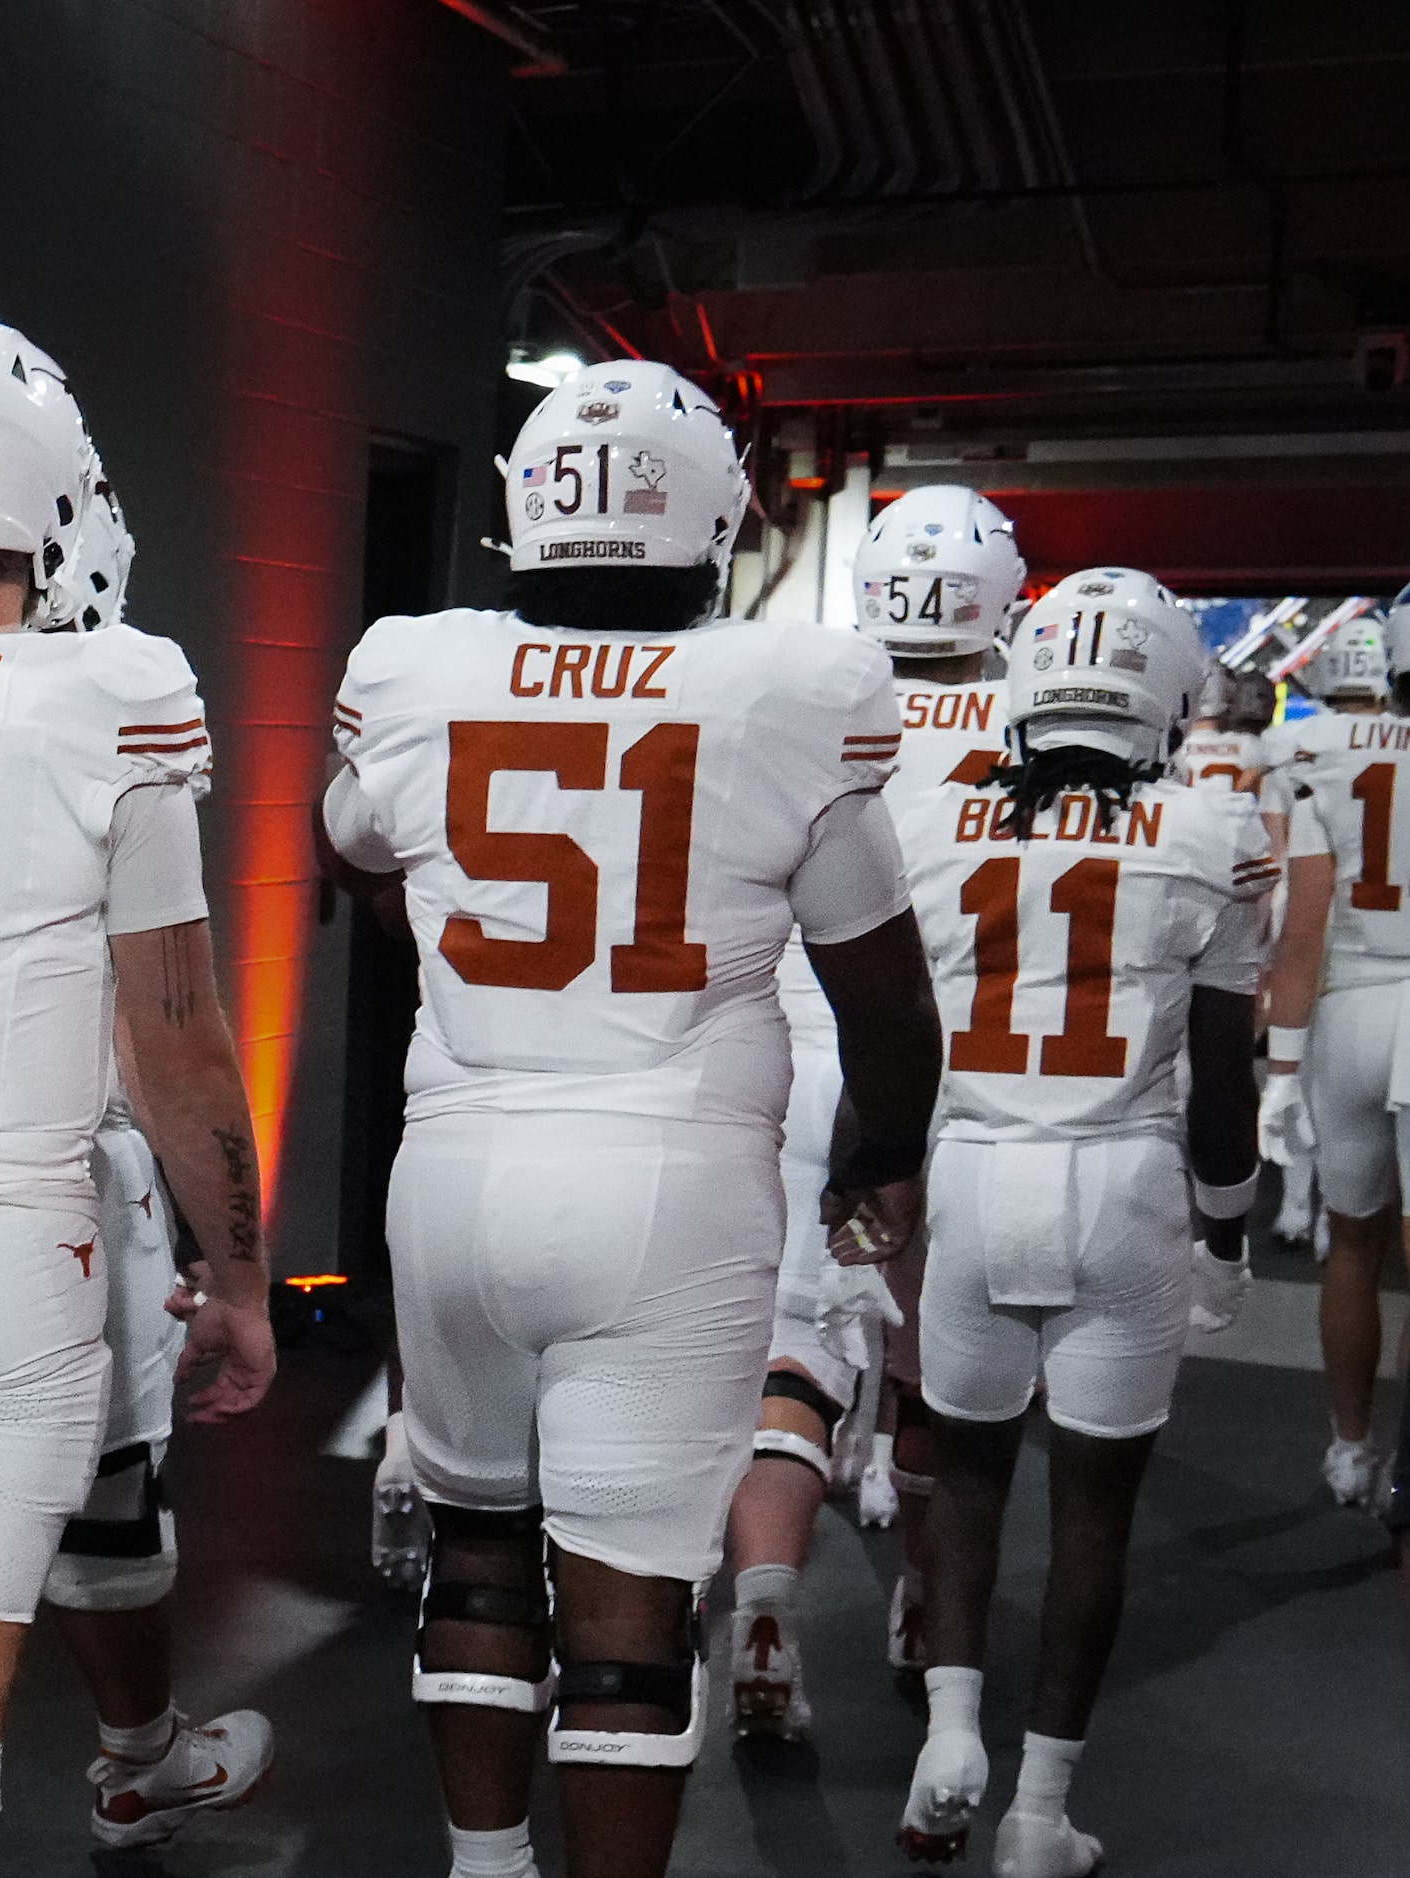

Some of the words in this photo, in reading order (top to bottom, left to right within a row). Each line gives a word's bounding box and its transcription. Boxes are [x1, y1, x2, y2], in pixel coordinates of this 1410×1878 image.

[554, 444, 609, 515] 51
[540, 541, 646, 562] LONGHORNS
[889, 575, 943, 625] 54
[1068, 610, 1105, 666] 11
[509, 643, 676, 698] CRUZ
[897, 692, 995, 731] SON
[438, 721, 708, 993] 51
[949, 856, 1128, 1078] 11
[439, 1682, 508, 1695] DONJOY
[560, 1741, 629, 1753] DONJOY
